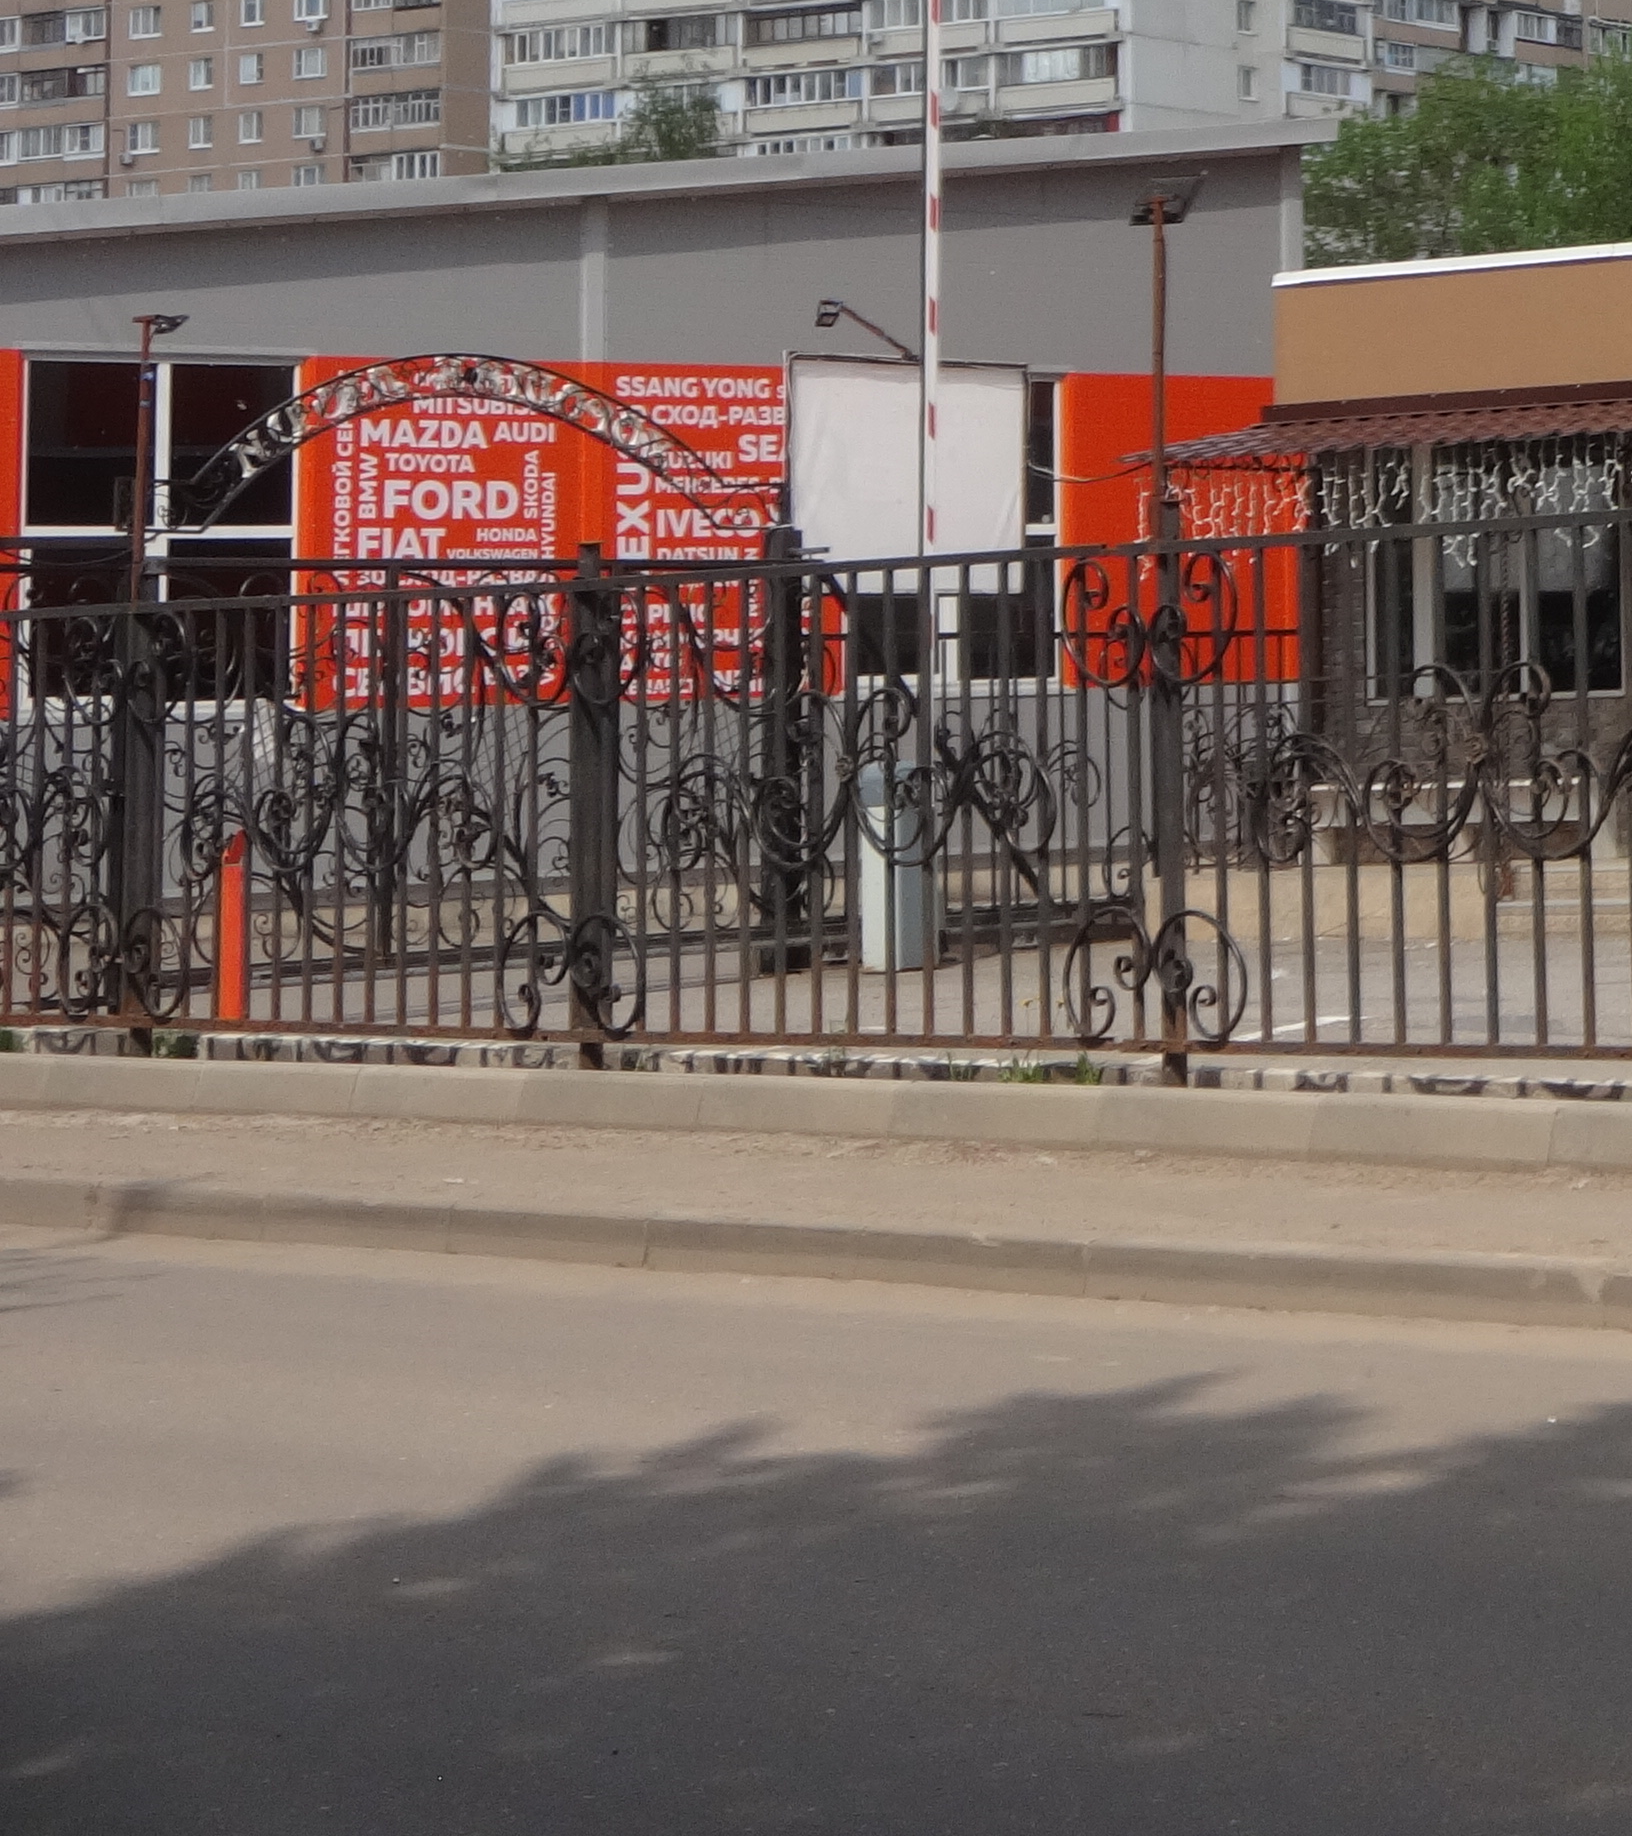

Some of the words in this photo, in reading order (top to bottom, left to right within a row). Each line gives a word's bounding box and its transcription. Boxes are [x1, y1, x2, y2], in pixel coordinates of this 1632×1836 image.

[615, 376, 698, 398] SSANG
[700, 377, 771, 400] YONG
[652, 404, 786, 429] СХОД-РАЗВ
[359, 418, 489, 449] MAZDA
[493, 421, 557, 443] AUDI
[384, 452, 476, 473] TOYOTA
[357, 452, 378, 519] BMW
[523, 449, 540, 519] SKODA
[383, 479, 518, 520] FORD
[541, 472, 557, 560] HYUNDAI
[655, 508, 761, 538] IVECO
[357, 527, 446, 560] FIAT
[476, 528, 538, 543] HONDA
[446, 548, 538, 560] VOLKSWAGEN
[656, 547, 739, 560] DATSUN
